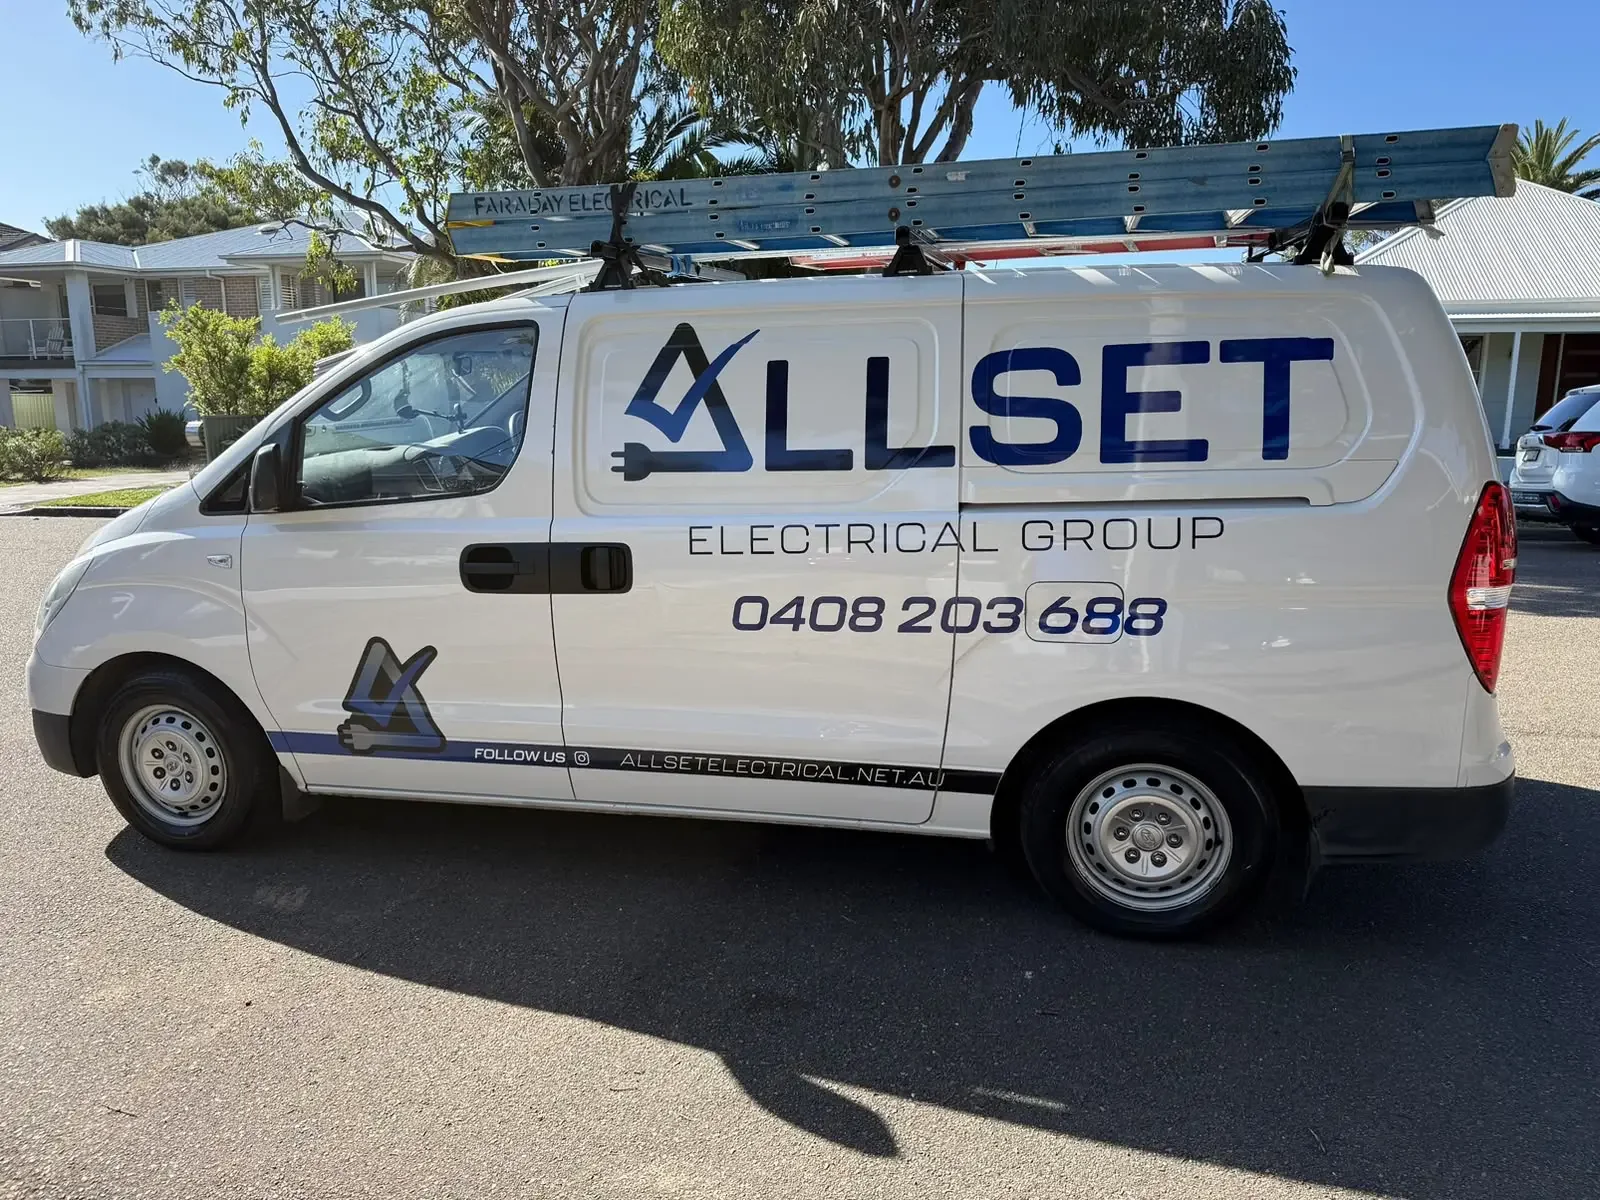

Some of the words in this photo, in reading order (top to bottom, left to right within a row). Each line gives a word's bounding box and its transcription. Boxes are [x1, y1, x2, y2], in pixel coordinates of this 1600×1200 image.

[474, 191, 565, 217] FARADAY
[568, 187, 693, 213] ELECRICAL
[611, 322, 1335, 482] ALLSET
[689, 520, 998, 556] ELECTRICAL
[1021, 516, 1225, 552] GROUP
[732, 595, 886, 633] 0408
[897, 598, 1023, 635] 203
[1038, 597, 1168, 637] 688
[474, 748, 541, 763] FOLLOW
[543, 752, 567, 765] US
[620, 752, 945, 788] ALLSETELECTRICAL.NET.AU
